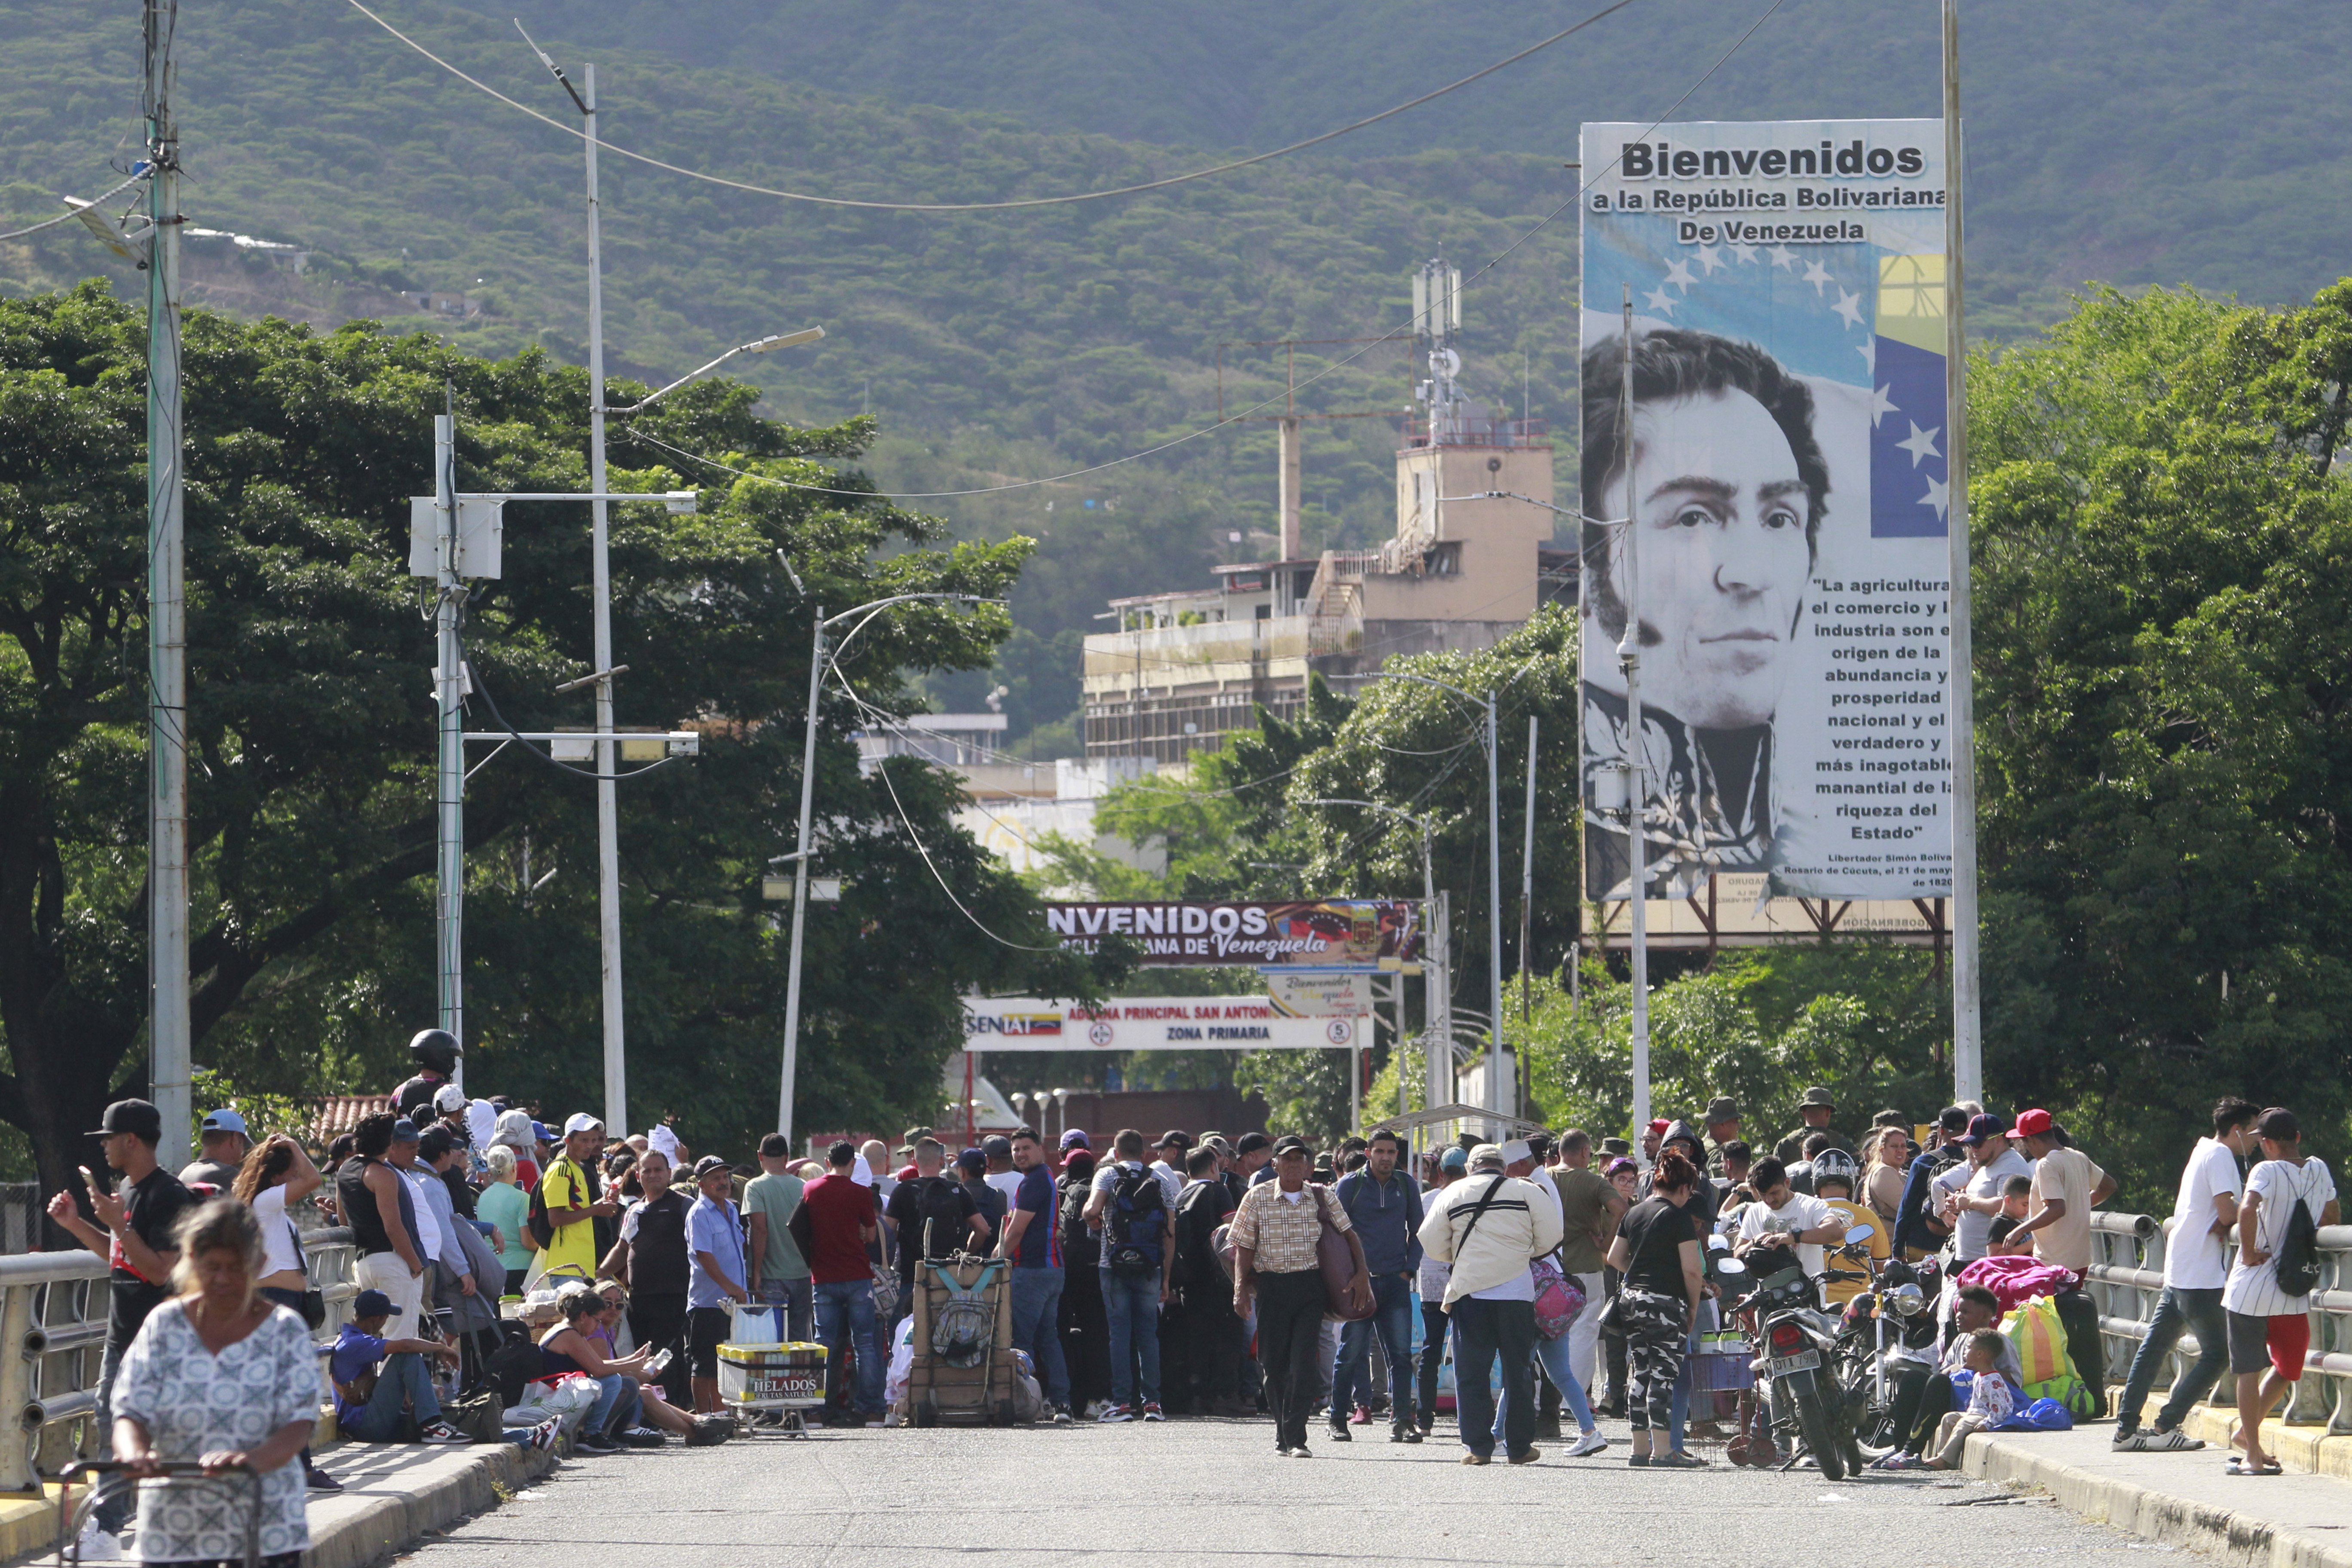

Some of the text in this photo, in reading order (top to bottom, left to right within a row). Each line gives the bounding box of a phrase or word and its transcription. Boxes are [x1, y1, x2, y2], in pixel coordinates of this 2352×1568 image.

[1622, 140, 1923, 177] Bienvenidos
[1593, 194, 1608, 208] a
[1619, 190, 1643, 208] la
[1654, 189, 1786, 212] República
[1680, 221, 1864, 241] De Venezuela
[1813, 579, 1843, 591] "La
[1812, 602, 1828, 614] el
[1835, 602, 1920, 614] comercio
[1926, 604, 1936, 616] y
[1815, 625, 1949, 636] industria son e
[1832, 647, 1940, 662] origen de la
[1825, 669, 1947, 683] abundancia y
[1832, 692, 1941, 707] prosperidad
[1828, 714, 1944, 729] nacional y el
[1832, 737, 1941, 751] verdadero y
[1816, 759, 1853, 771] más
[1816, 782, 1905, 793] manantial
[1913, 782, 1934, 793] de
[1836, 804, 1936, 819] riqueza del
[1852, 826, 1922, 839] Estado"
[1886, 854, 1917, 862] Simón
[1920, 853, 1952, 861] Bolíva
[1842, 867, 1882, 876] Cúcuta,
[1047, 906, 1268, 935] NVENIDOS
[1185, 938, 1209, 955] DE
[1210, 930, 1330, 960] Venezuela
[1286, 975, 1351, 988] Bienvenidos
[1294, 987, 1354, 1003] Venezuela
[1124, 1007, 1190, 1019] PRINCIPAL
[1195, 1006, 1219, 1019] SAN
[967, 1015, 1033, 1034] SENIAT
[1335, 1024, 1343, 1035] 5
[1167, 1026, 1270, 1040] ZONA PRIMARIA
[754, 1379, 816, 1392] HELADOS
